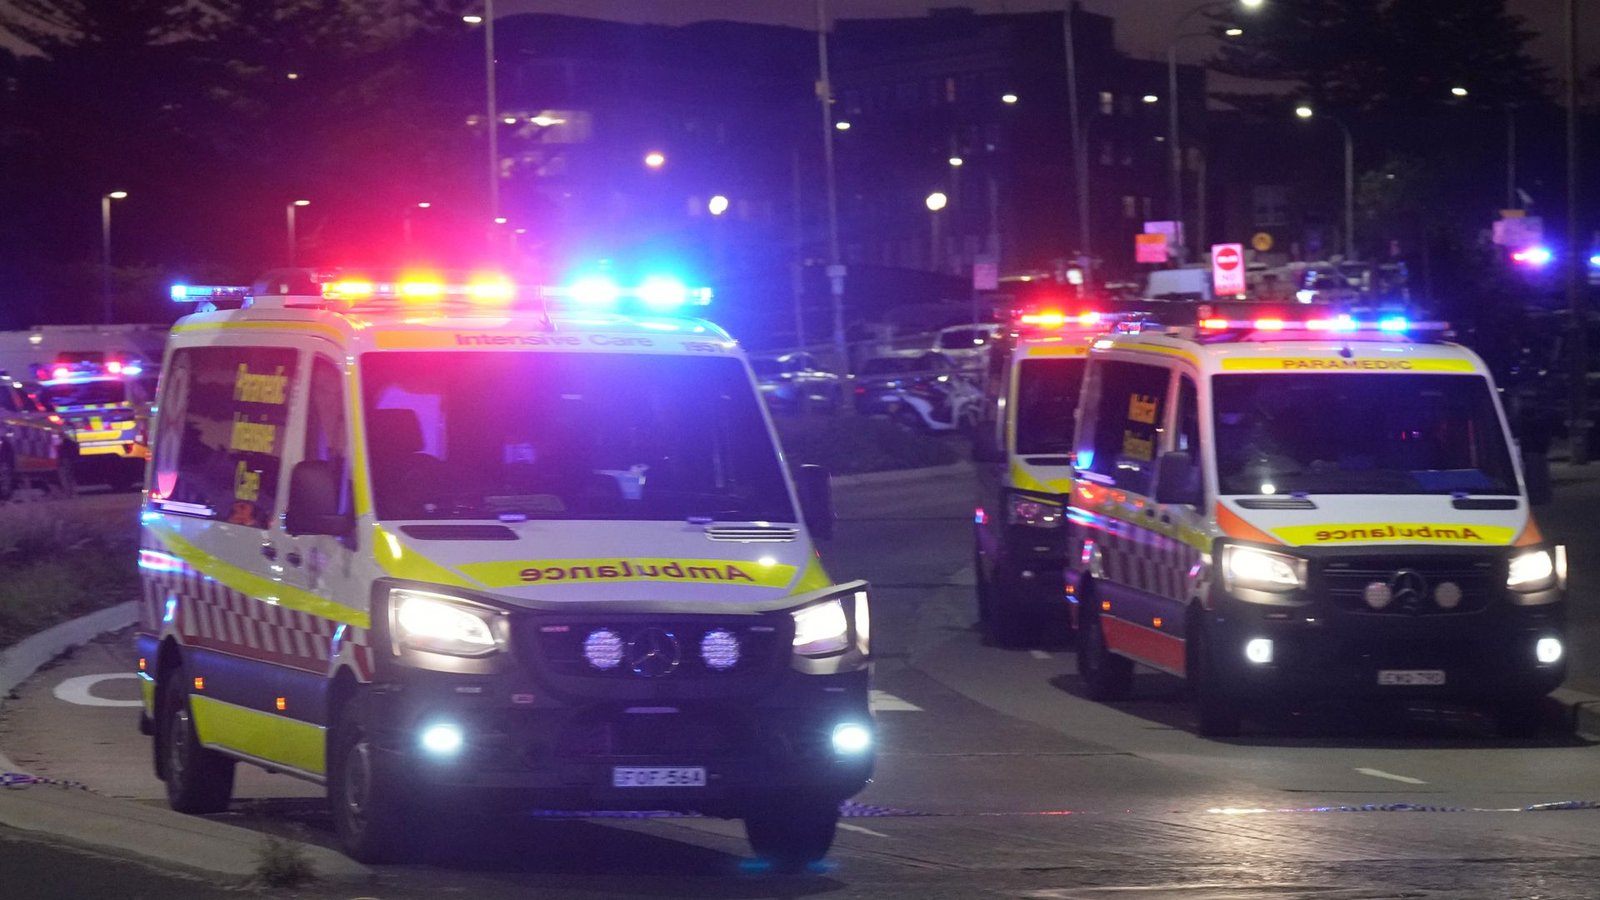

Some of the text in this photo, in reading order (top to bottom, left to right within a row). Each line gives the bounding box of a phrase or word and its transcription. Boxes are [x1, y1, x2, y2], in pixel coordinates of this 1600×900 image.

[455, 333, 654, 347] Intensive Care
[1282, 359, 1413, 370] PARAMEDIC
